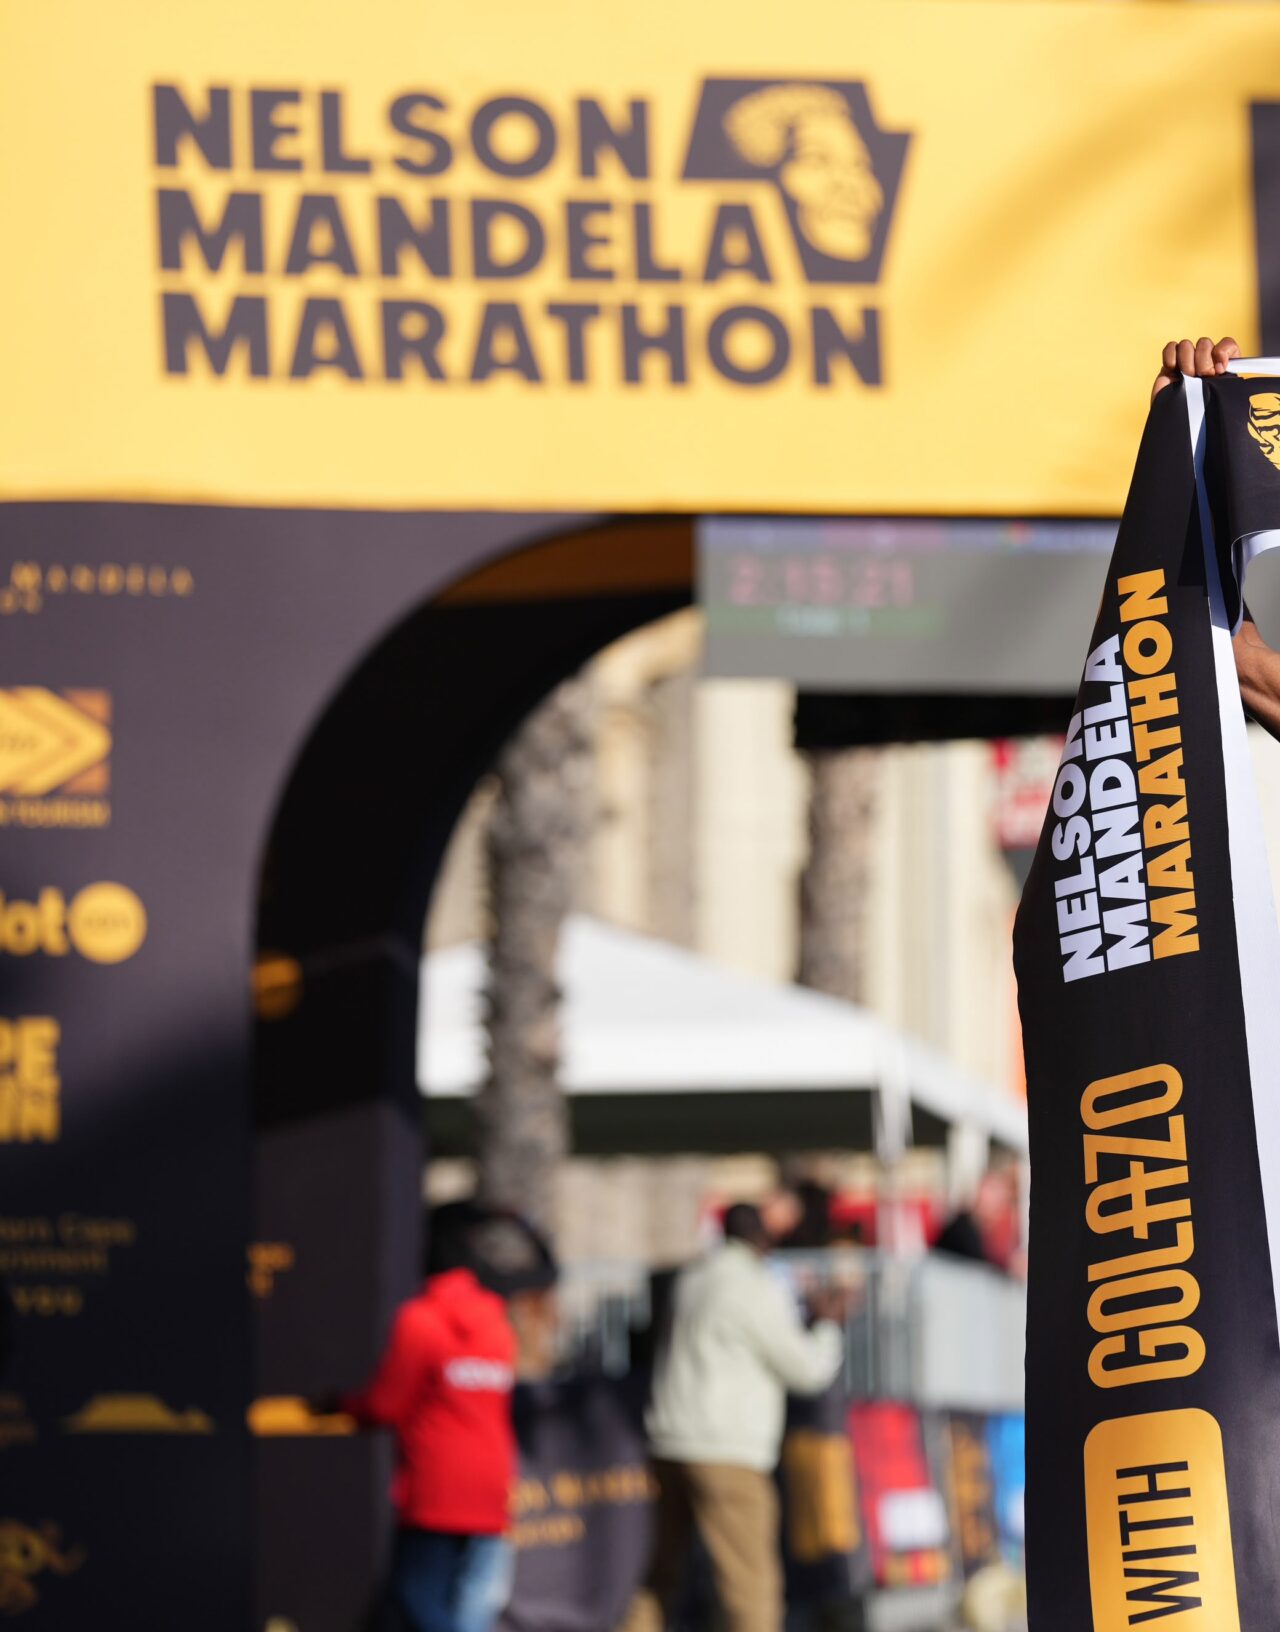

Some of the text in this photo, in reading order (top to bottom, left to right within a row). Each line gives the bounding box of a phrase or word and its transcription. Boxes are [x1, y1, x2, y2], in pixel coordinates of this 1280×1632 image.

[152, 83, 650, 180] NELSON
[155, 187, 775, 285] MANDELA
[161, 290, 885, 387] MARATHON
[1051, 711, 1106, 983] NELSON
[1083, 633, 1151, 972] MANDELA
[1117, 568, 1200, 960] MARATHON
[1080, 1063, 1206, 1389] GOLAZO
[1116, 1461, 1203, 1626] WITH
